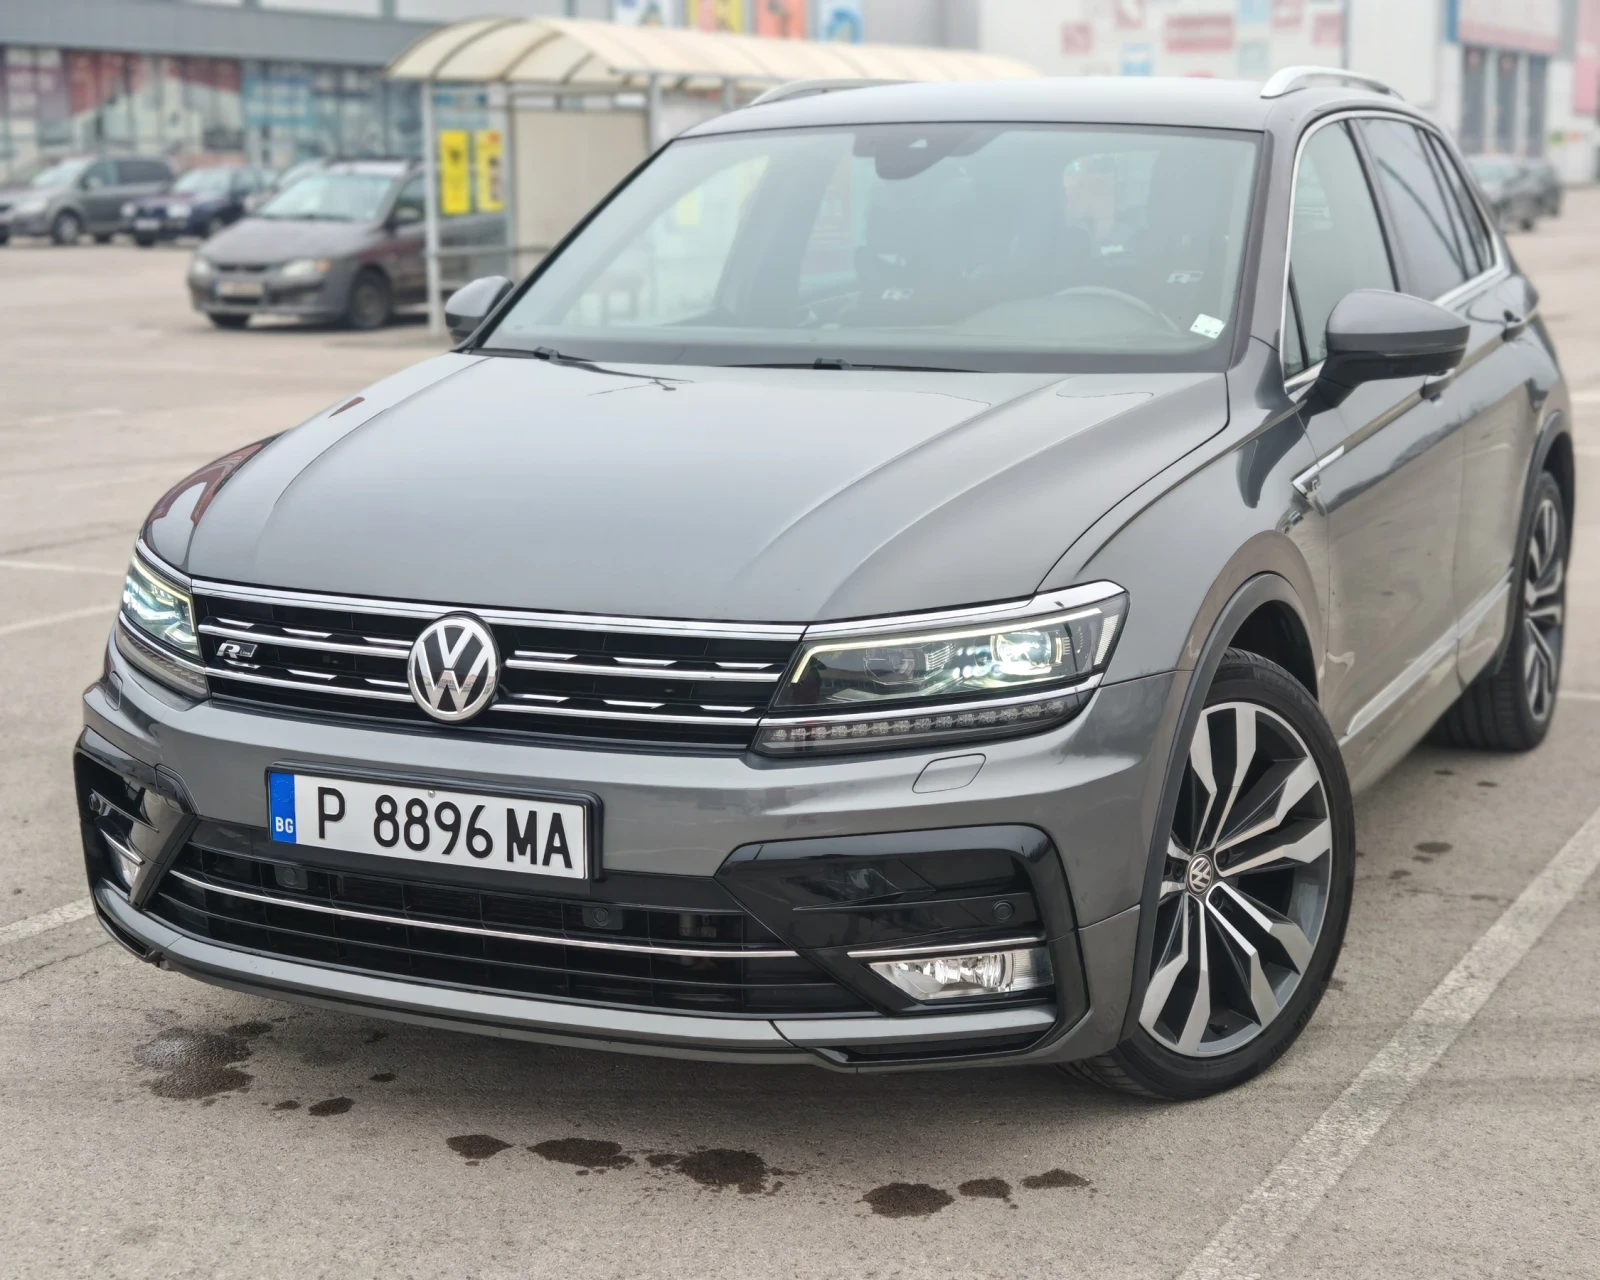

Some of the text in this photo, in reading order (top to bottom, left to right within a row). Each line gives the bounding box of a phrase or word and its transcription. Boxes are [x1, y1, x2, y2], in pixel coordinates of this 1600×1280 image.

[408, 613, 499, 721] VW
[275, 816, 294, 834] BG
[317, 786, 573, 869] P 8896 MA
